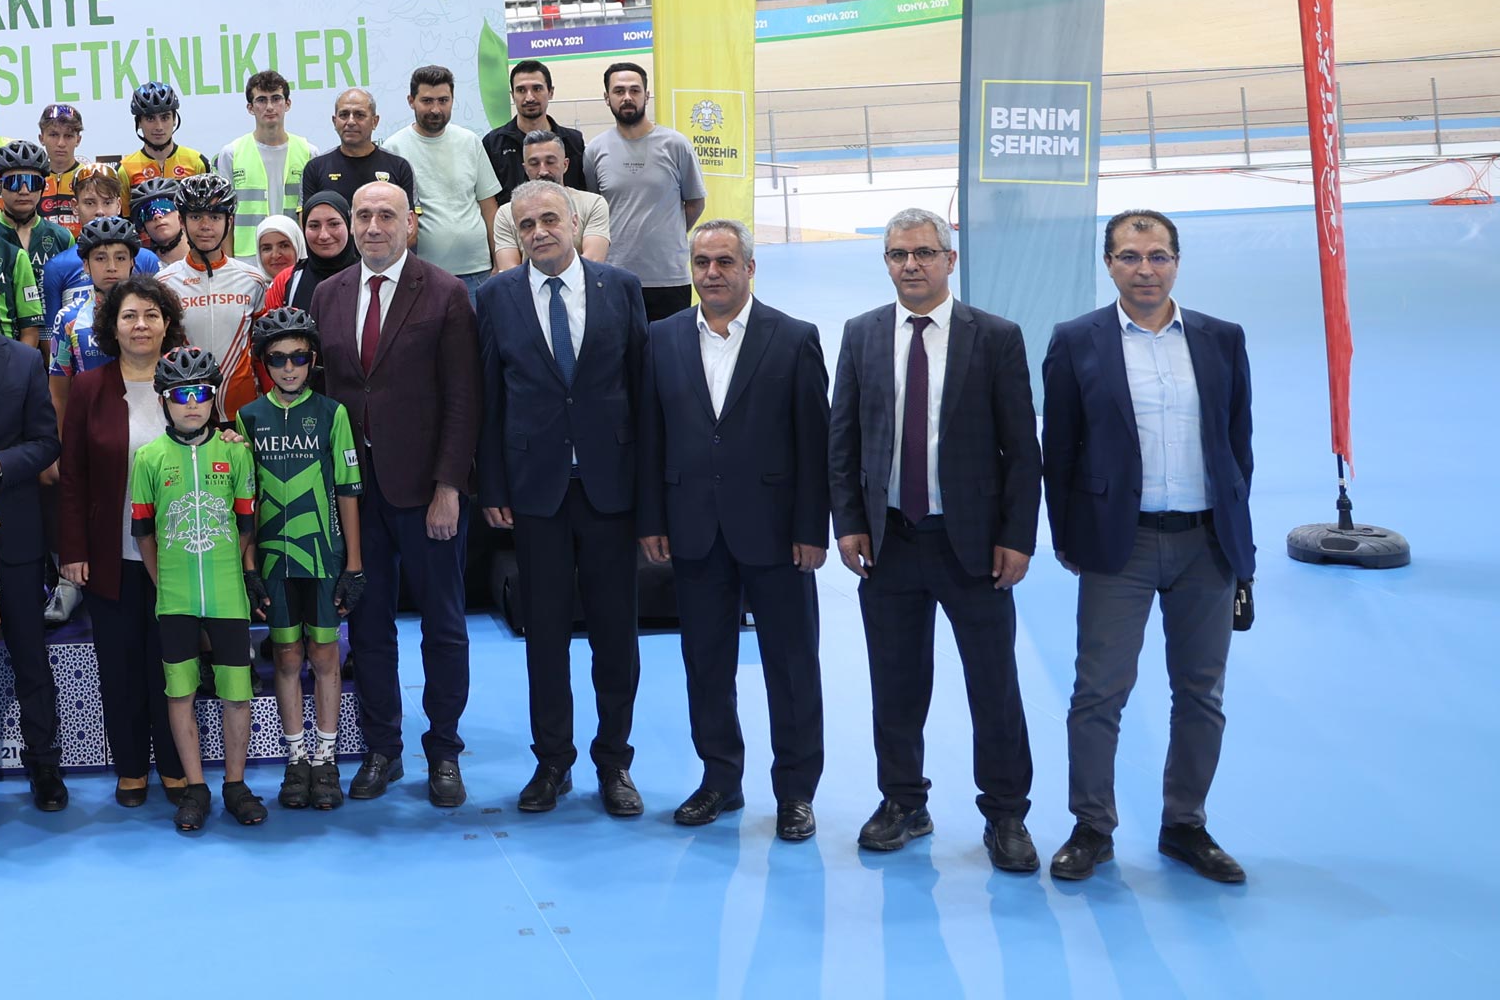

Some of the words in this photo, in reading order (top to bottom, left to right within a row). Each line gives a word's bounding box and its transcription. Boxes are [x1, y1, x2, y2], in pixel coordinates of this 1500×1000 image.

[897, 1, 929, 13] KONYA
[755, 19, 768, 29] 021
[807, 12, 838, 24] KONYA
[840, 10, 858, 20] 2021
[531, 37, 563, 49] KONYA
[564, 35, 584, 46] 2021
[693, 136, 720, 144] KONYA
[52, 296, 86, 335] KONYA
[254, 434, 320, 452] MERAM
